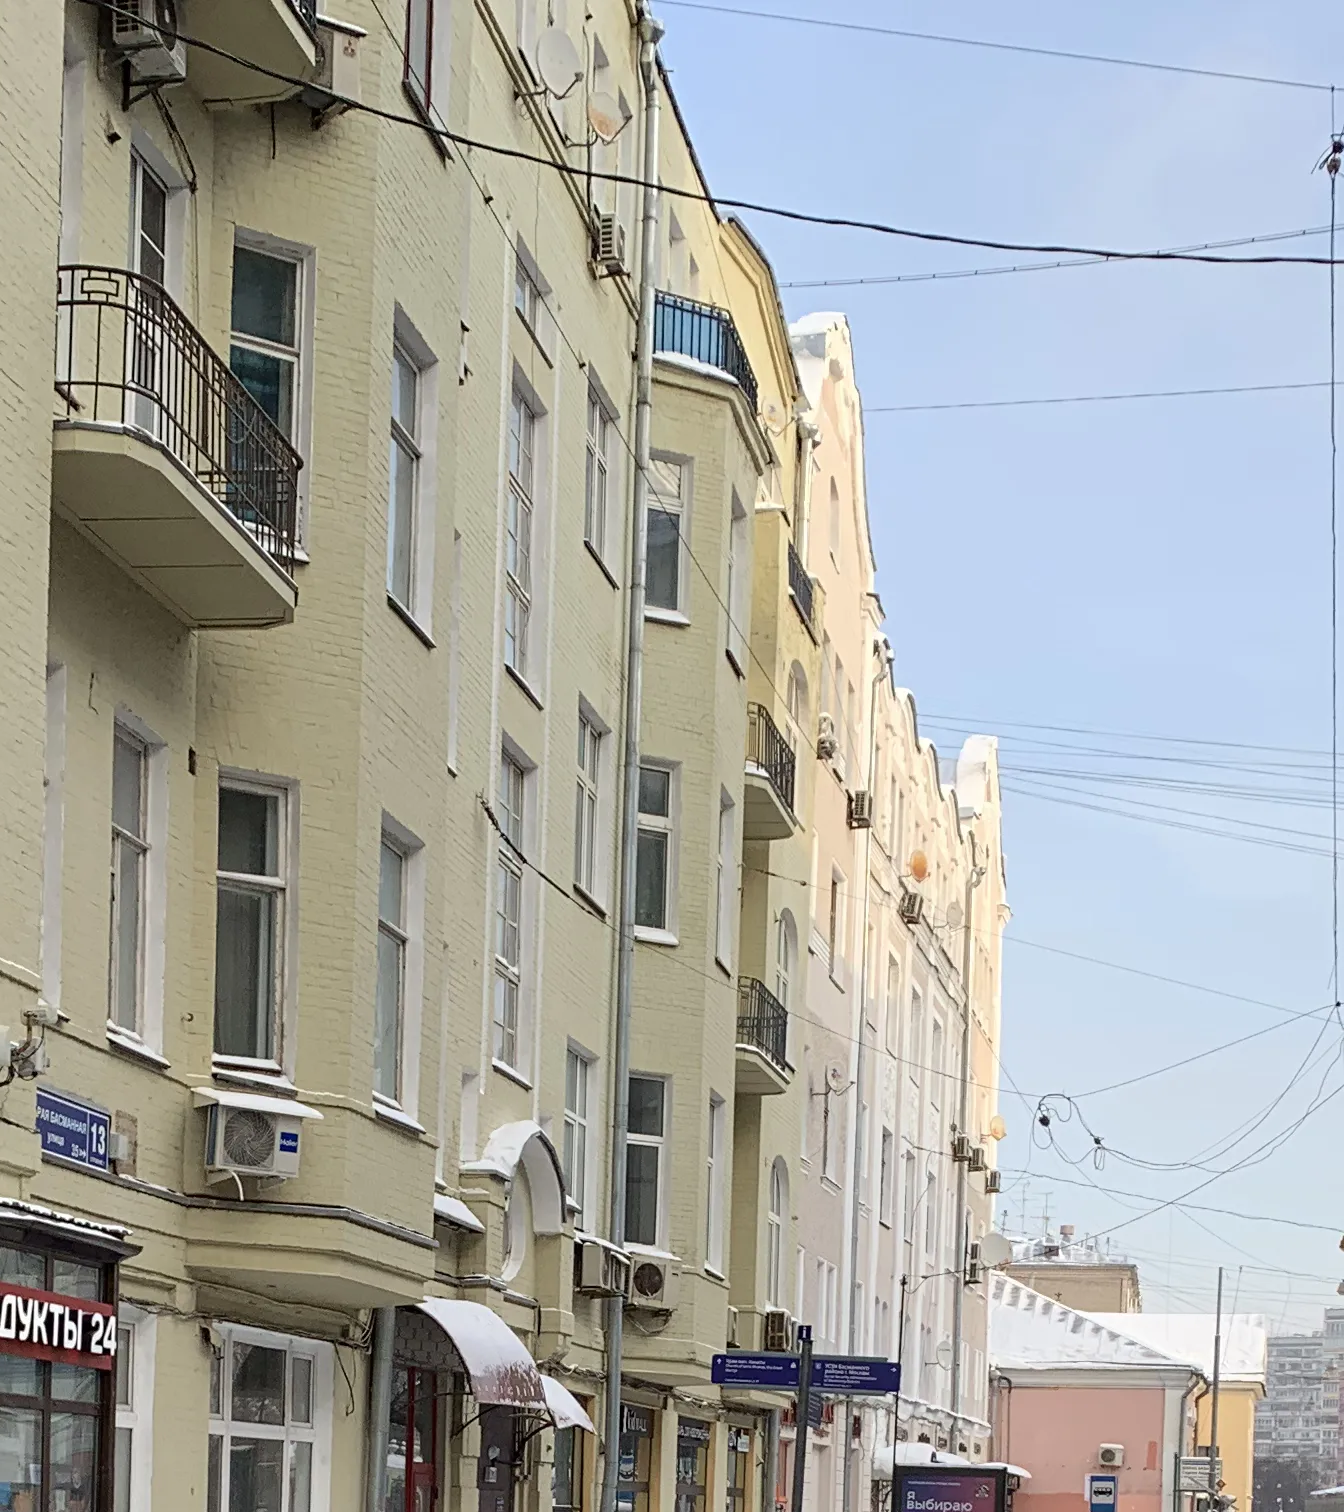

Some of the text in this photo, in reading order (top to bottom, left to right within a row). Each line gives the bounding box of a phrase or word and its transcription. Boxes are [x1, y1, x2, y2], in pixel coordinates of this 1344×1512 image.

[50, 1111, 87, 1134] БАСМАННАЯ
[91, 1123, 105, 1155] 13
[90, 1312, 117, 1356] 24
